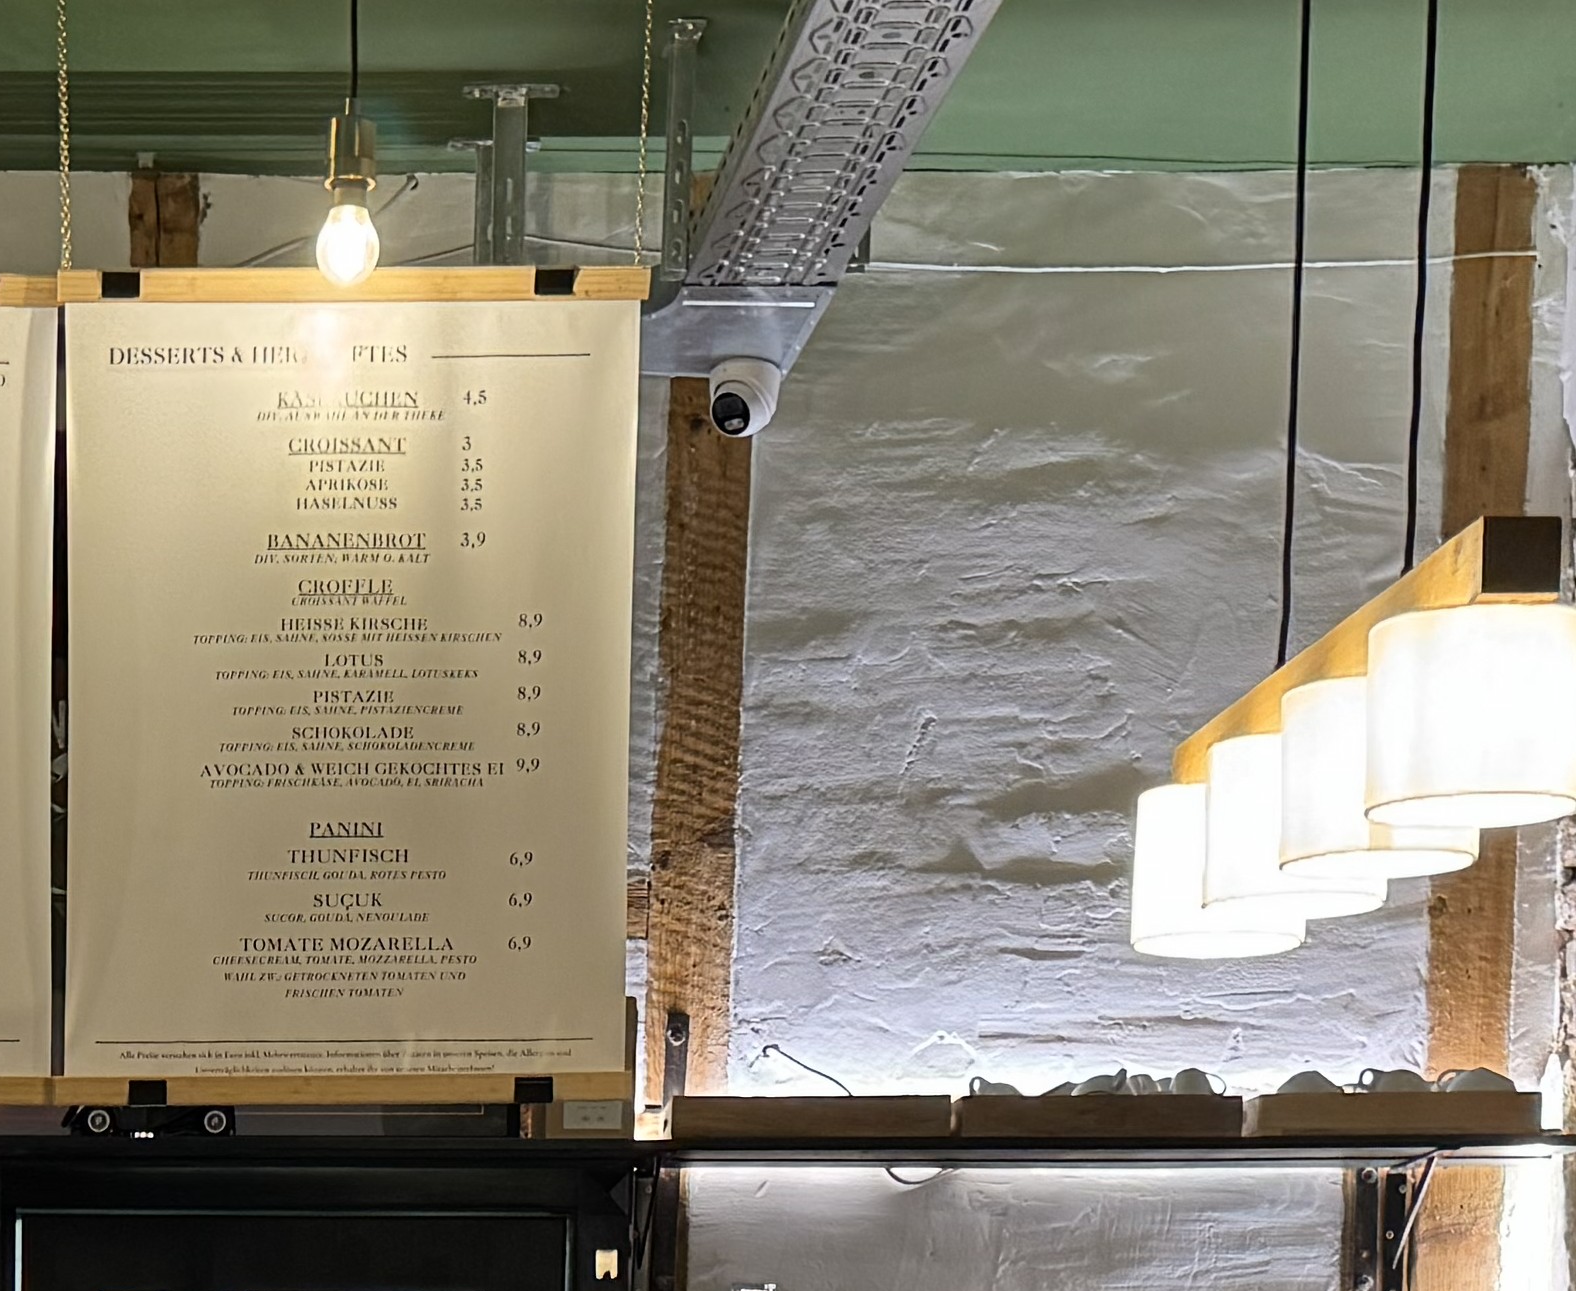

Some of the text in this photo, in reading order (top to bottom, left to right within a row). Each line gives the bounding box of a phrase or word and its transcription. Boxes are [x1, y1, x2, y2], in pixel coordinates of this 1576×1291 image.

[110, 347, 224, 364] DESSERTS
[289, 436, 471, 452] CROISSANT 3
[306, 478, 482, 492] APRIKOSE 3,5
[297, 496, 482, 511] HASELNUSS 3,5
[268, 532, 485, 548] BANANENBROT 3,9
[299, 579, 393, 594] CROFFLE
[282, 614, 542, 631] HEISSE KIRSCHE 8,9
[325, 650, 541, 666] LOTUS 8,9
[292, 722, 540, 739] SCHOKOLADE 8,9
[201, 758, 539, 777] AVOCADO & WEICH GEKOCHTES EI 9,9
[310, 822, 382, 836] PANINI
[288, 849, 532, 866] THUNFISCH 6,9
[313, 893, 532, 911] SUÇUK 6,9
[240, 936, 531, 952] TOMATE MOZARELLA 6,9
